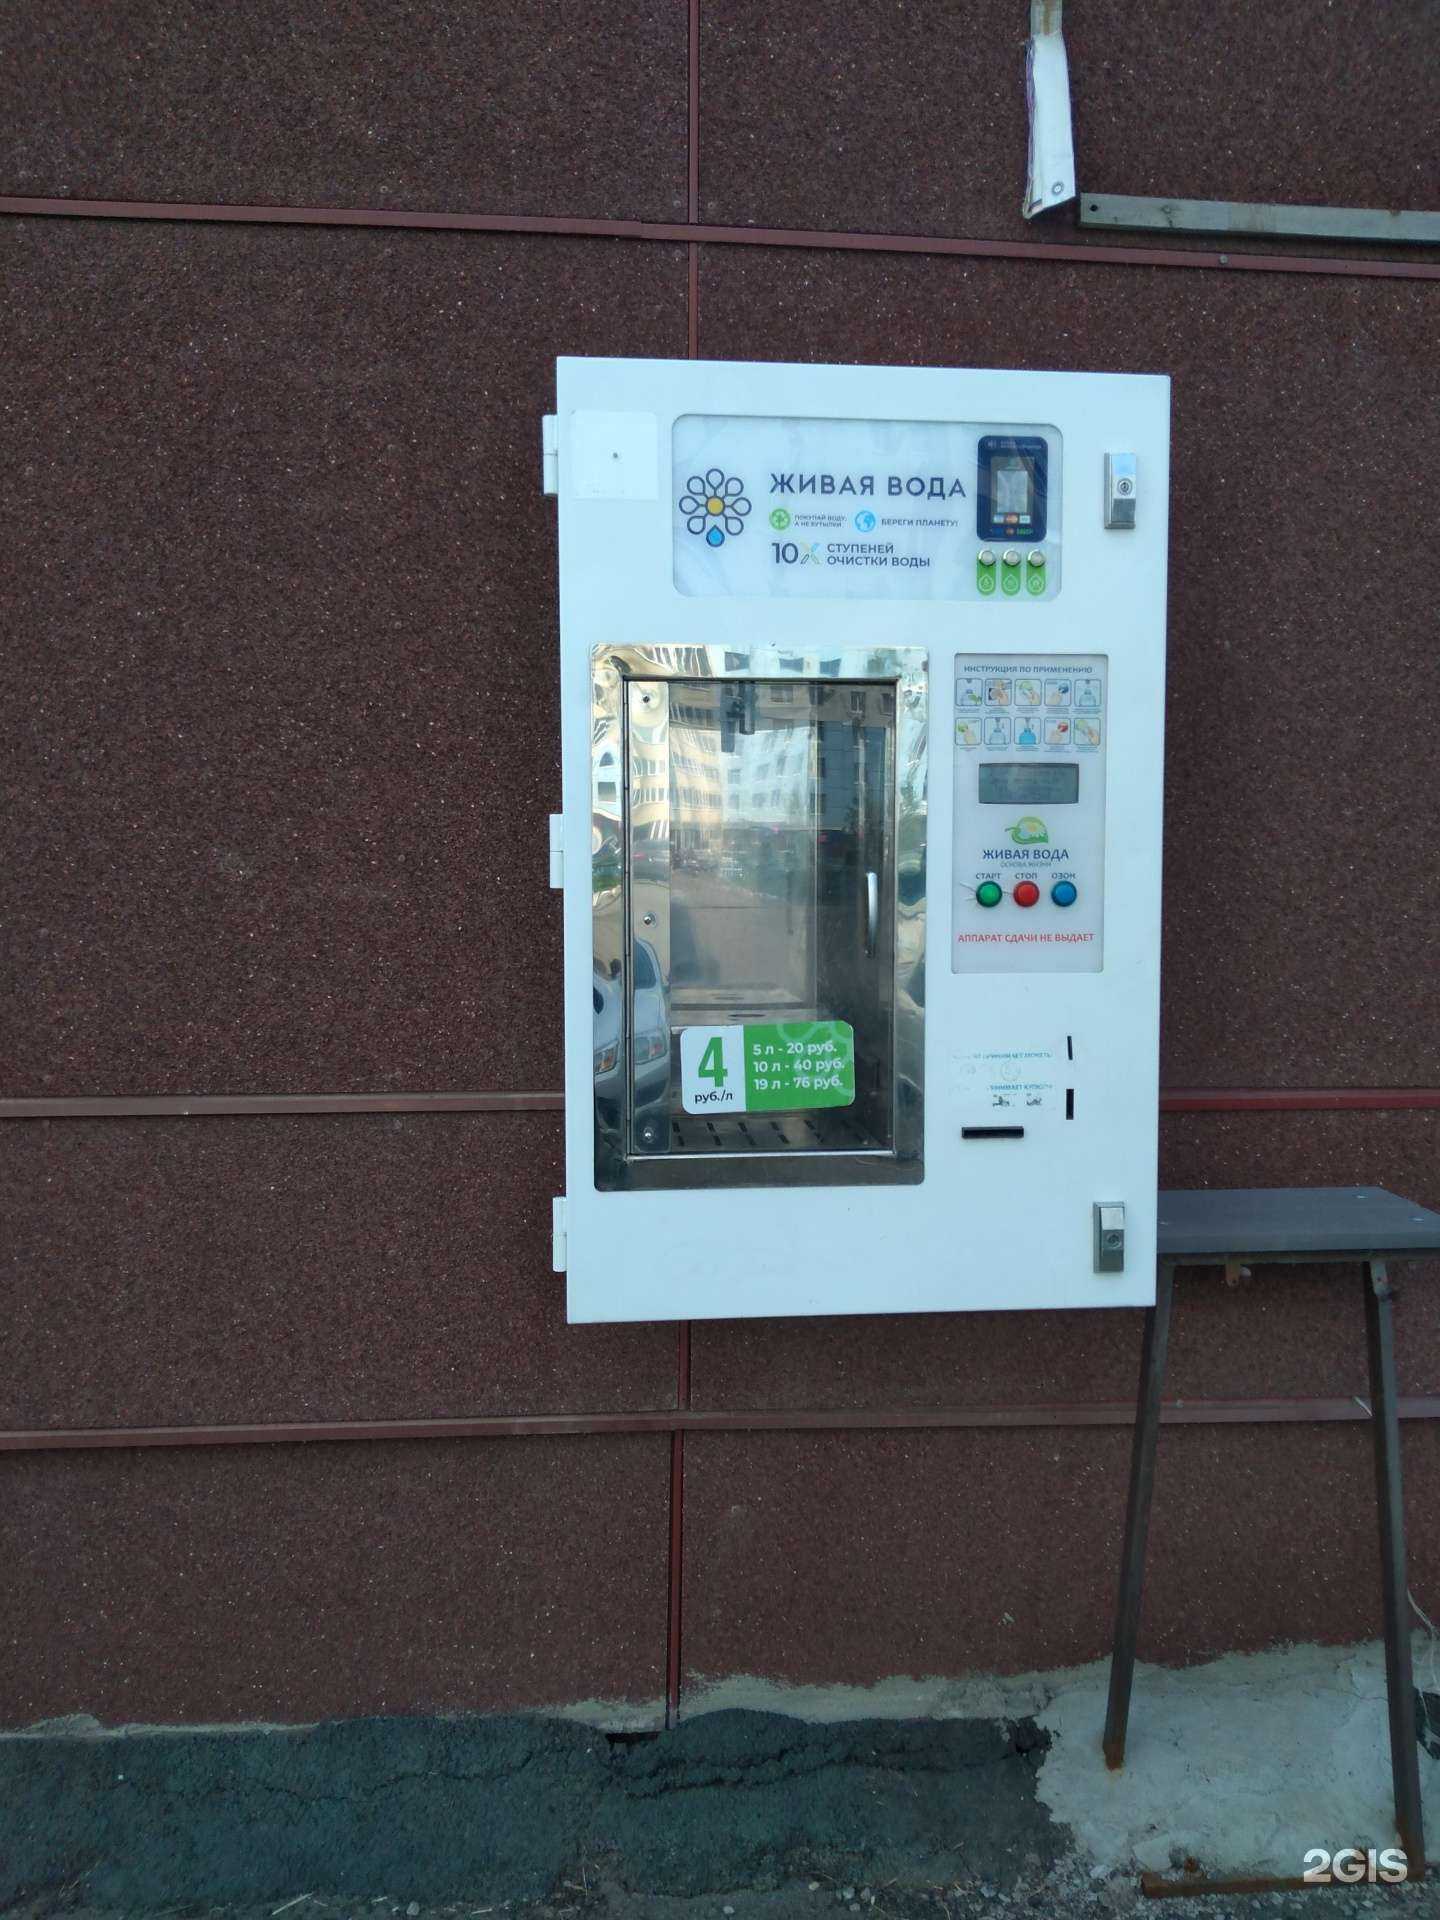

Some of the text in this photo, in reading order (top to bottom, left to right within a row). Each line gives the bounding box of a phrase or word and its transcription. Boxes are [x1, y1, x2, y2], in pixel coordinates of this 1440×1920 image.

[769, 472, 967, 500] ЖИВАЯ ВОДА
[881, 517, 914, 526] БЕРЕГИ
[827, 542, 894, 555] СТУПЕНЕЙ
[827, 556, 930, 568] ОЧИСТКИ ВОДЫ
[964, 665, 1094, 674] ИНСТРУКЦИЯ ПО ПРИМЕНЕНИЮ
[982, 849, 1069, 861] ЖИВАЯ ВОДА
[975, 872, 1076, 880] СТАРТ СТОП ОЗОН
[958, 933, 1095, 944] АППАРАТ СДАЧИ НЕ ВЫДАЕТ
[752, 1044, 761, 1056] 5
[763, 1045, 775, 1055] л
[786, 1041, 804, 1054] 20
[807, 1041, 837, 1054] руб.
[697, 1036, 729, 1087] 4
[753, 1061, 768, 1073] 10
[771, 1062, 781, 1072] л
[793, 1059, 812, 1071] 40
[815, 1057, 845, 1073] руб.
[754, 1078, 769, 1090] 19
[771, 1079, 781, 1090] л
[793, 1076, 810, 1089] 76
[813, 1075, 843, 1090] руб.
[694, 1089, 733, 1104] руб./л
